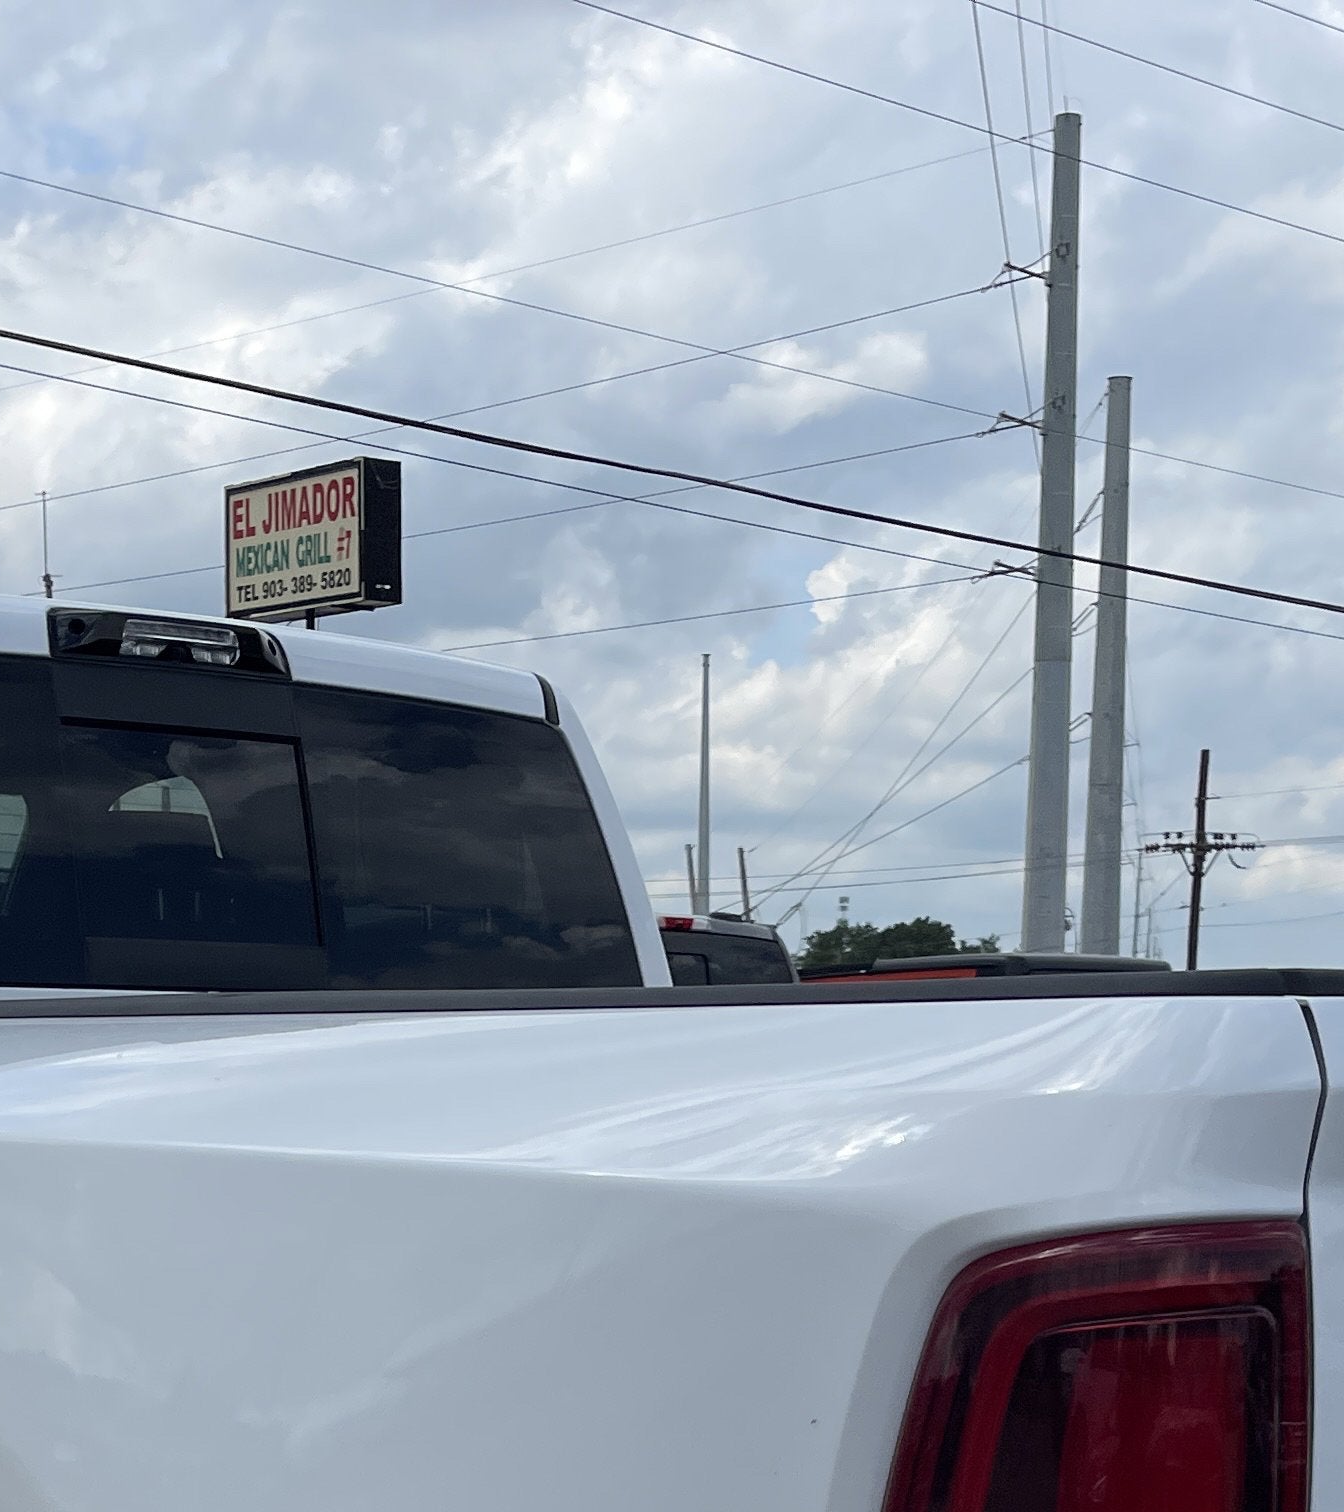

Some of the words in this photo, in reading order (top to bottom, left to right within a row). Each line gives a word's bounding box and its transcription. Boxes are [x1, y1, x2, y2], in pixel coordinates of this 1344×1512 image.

[233, 498, 256, 540] EL
[262, 476, 356, 534] JIMADOR
[236, 539, 290, 577] MEXICAN
[296, 532, 331, 568] GRILL
[237, 584, 259, 603] TEL
